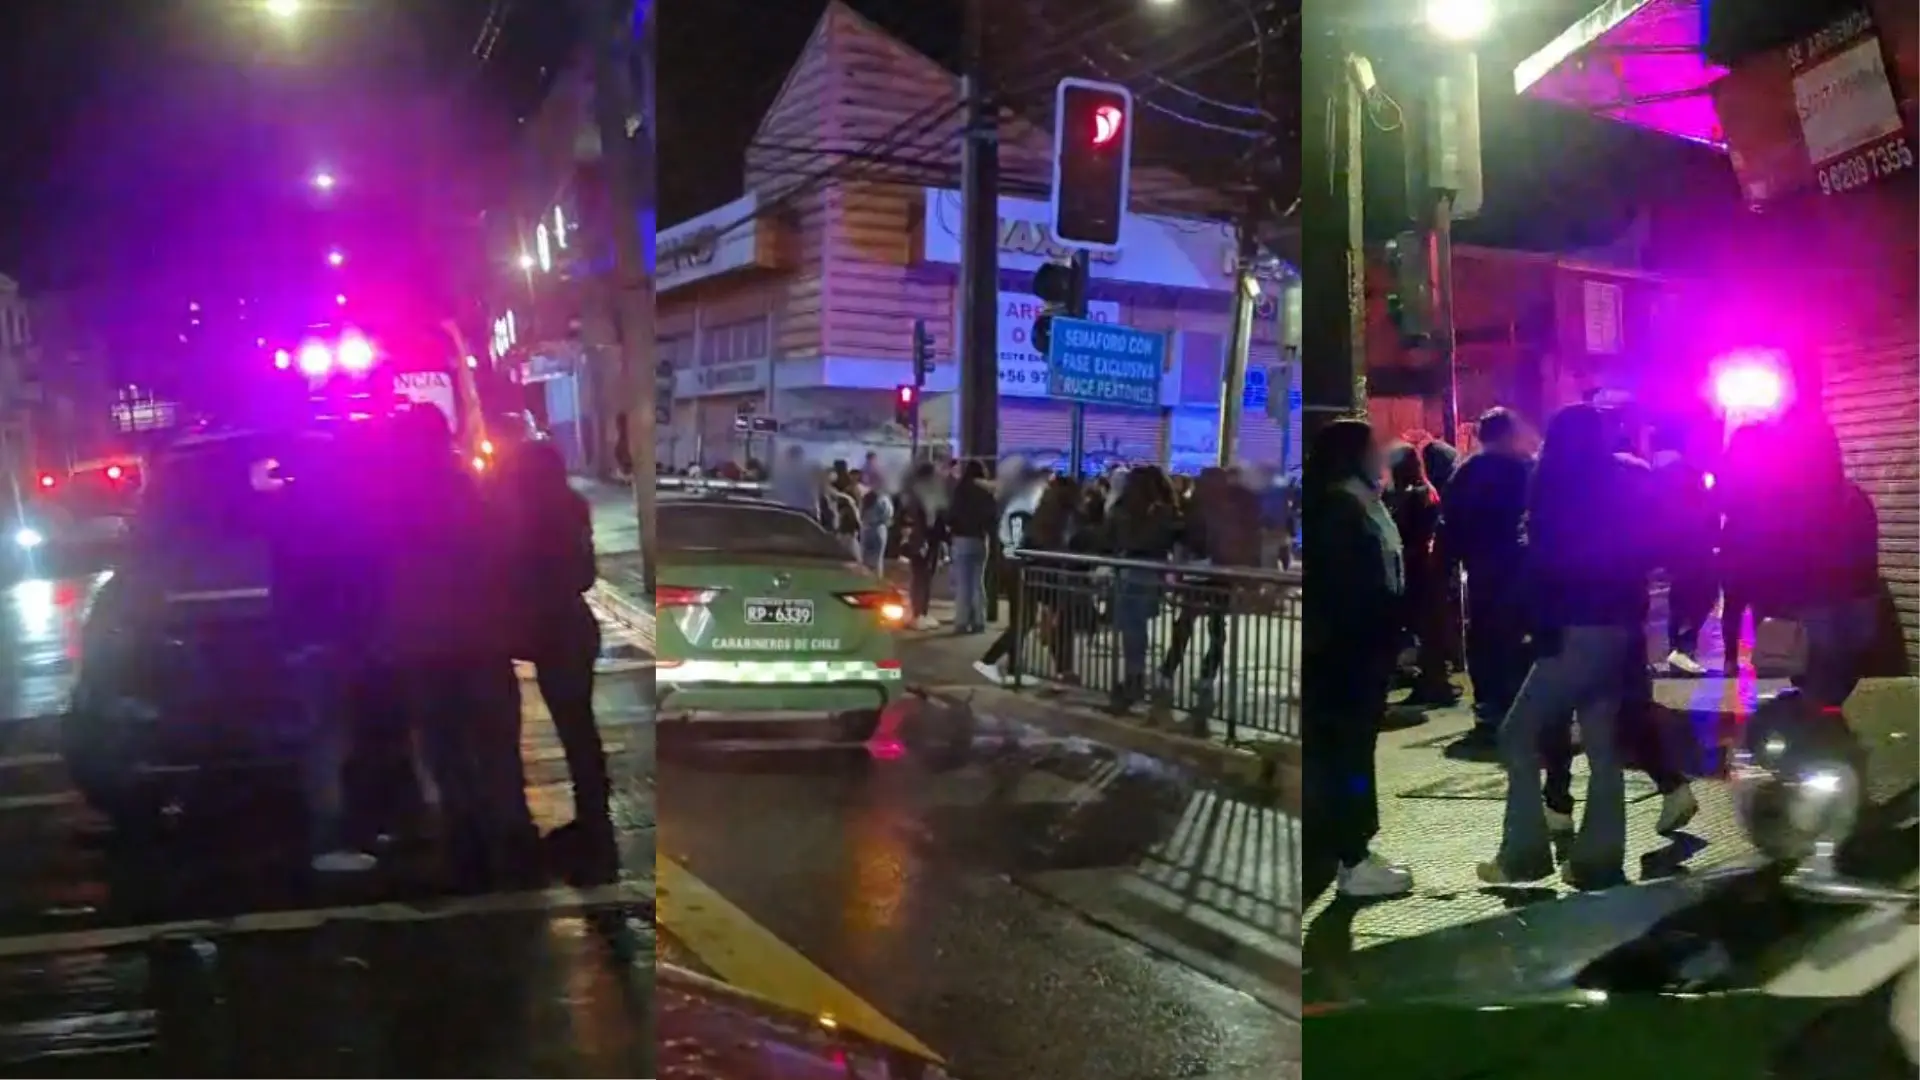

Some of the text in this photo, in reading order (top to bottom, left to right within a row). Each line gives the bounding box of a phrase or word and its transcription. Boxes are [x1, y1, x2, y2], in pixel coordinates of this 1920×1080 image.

[1128, 335, 1154, 356] CON
[1063, 352, 1155, 379] FASE EXCLUSIVA
[400, 374, 447, 390] NCIA
[1058, 375, 1094, 396] RUCE
[711, 638, 841, 651] CARABINEROS DE CHILE
